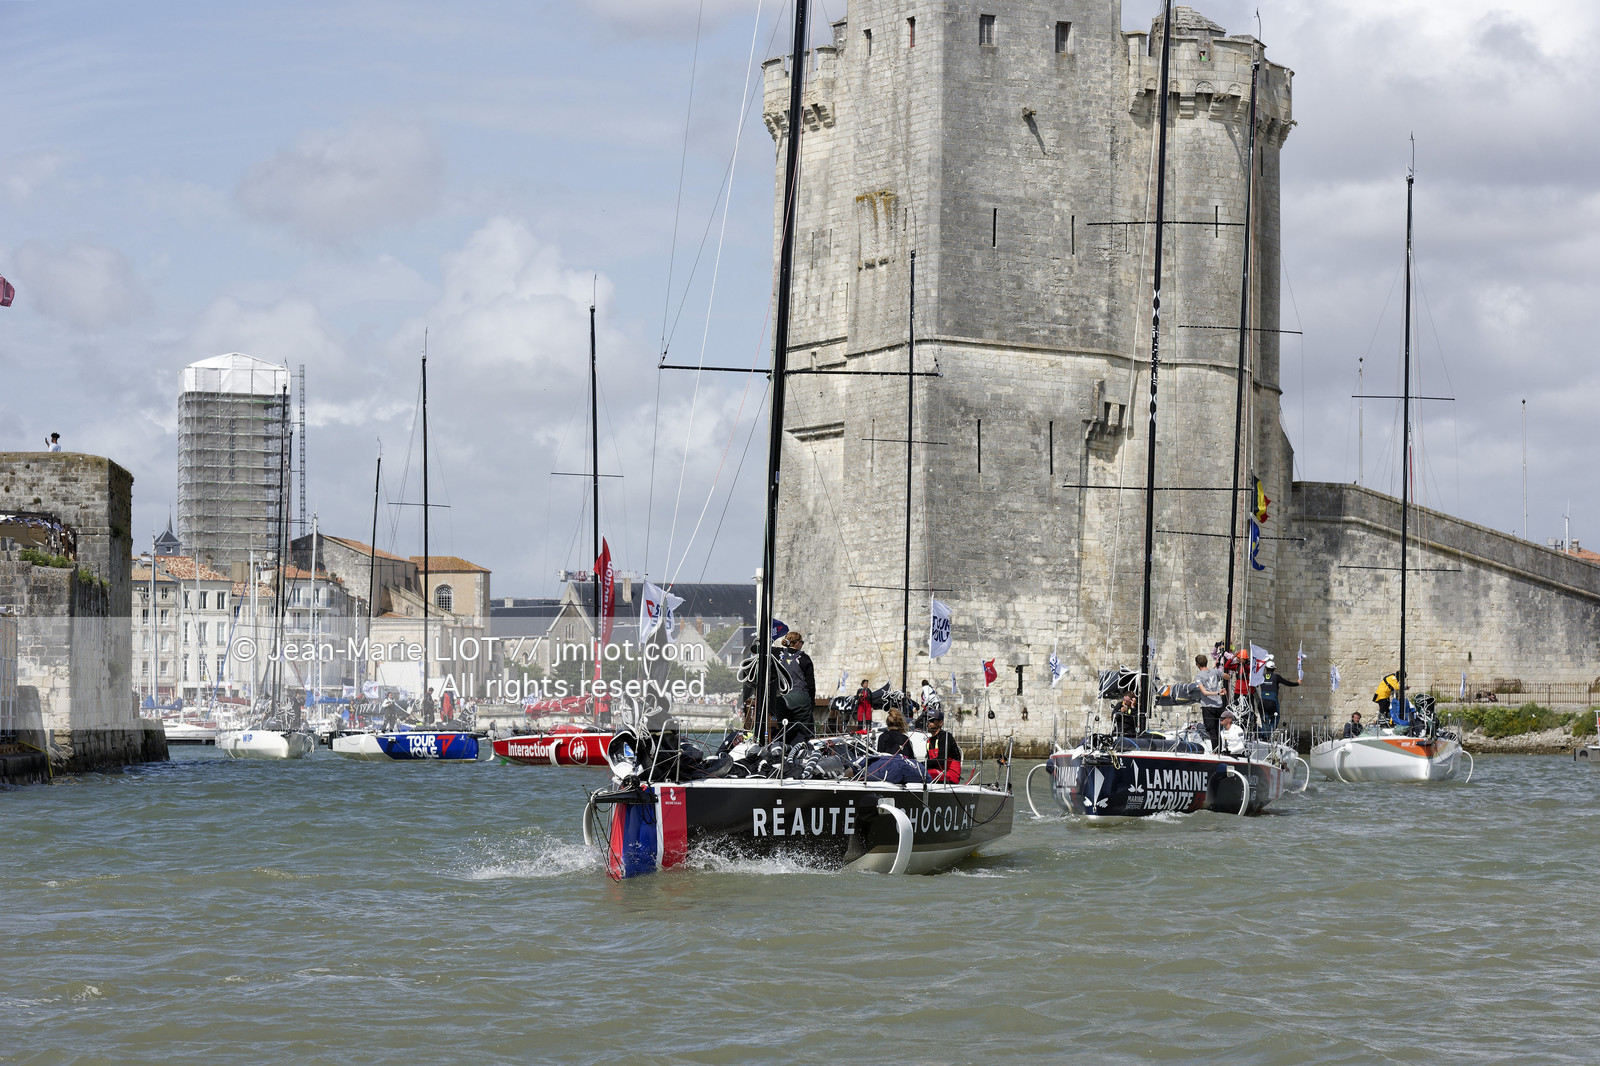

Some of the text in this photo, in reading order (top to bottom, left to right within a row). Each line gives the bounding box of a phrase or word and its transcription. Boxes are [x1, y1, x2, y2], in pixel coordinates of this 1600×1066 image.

[406, 735, 436, 747] TOUR
[410, 747, 439, 758] VOILE
[508, 741, 551, 757] Interaction
